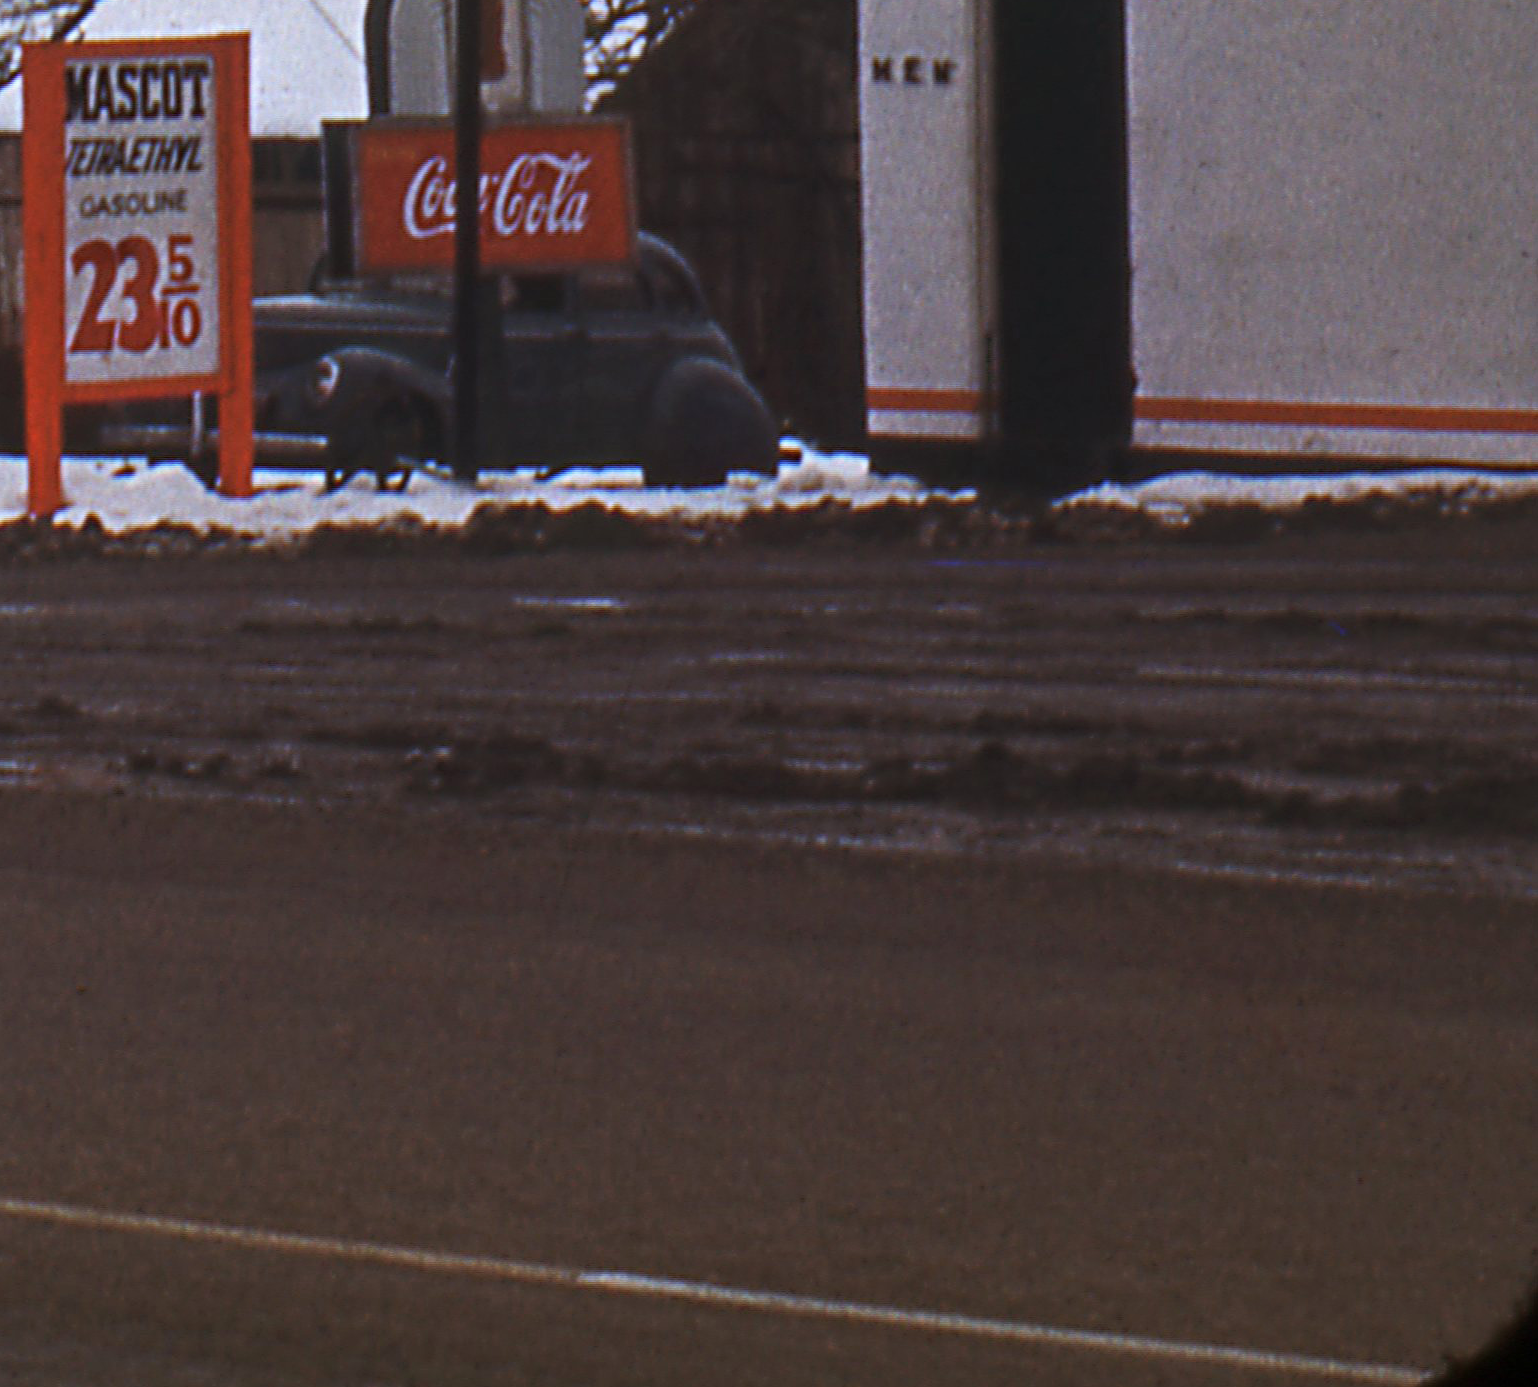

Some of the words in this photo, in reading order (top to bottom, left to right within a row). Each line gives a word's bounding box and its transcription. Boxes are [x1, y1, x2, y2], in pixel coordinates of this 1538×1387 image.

[66, 60, 208, 122] MASCOT
[66, 136, 203, 176] TETRAETHYL
[80, 190, 189, 217] GASOLINE
[70, 235, 158, 354] 23
